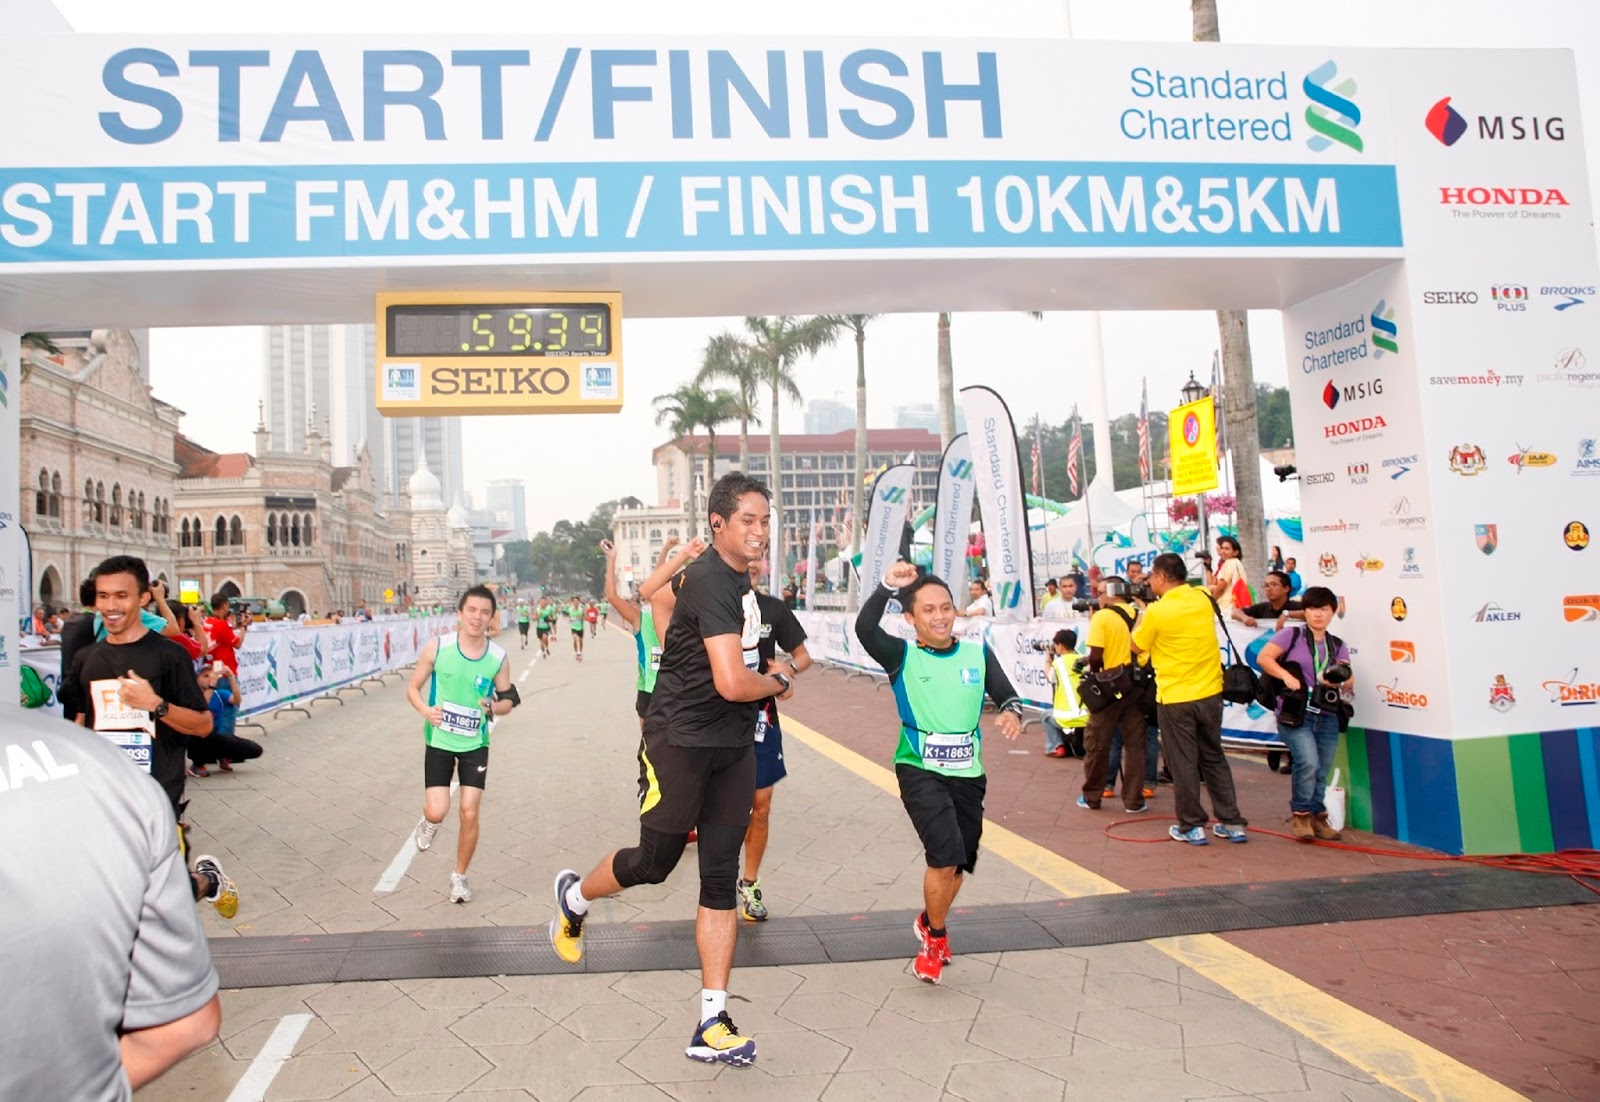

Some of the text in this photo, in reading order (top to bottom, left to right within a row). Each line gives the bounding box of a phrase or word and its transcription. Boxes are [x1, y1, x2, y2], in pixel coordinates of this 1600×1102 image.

[98, 47, 1003, 145] START/FINISH
[1131, 67, 1287, 101] Standard
[1120, 108, 1291, 142] Chartered
[1477, 115, 1566, 141] MSIG
[1438, 187, 1571, 206] HONDA
[0, 180, 267, 248] START
[295, 175, 599, 242] FM&HM
[680, 173, 930, 238] FINISH
[956, 174, 1341, 234] 10KM&5KM
[1452, 209, 1562, 220] The Power of Dreams
[1423, 291, 1479, 304] SEIKO
[1539, 286, 1596, 295] BROOKS
[1497, 302, 1527, 312] PLUS
[1304, 313, 1366, 350] Standard
[1302, 338, 1368, 374] Chartered
[431, 367, 570, 395] SEIKO
[1343, 378, 1384, 402] MSIG
[1324, 415, 1388, 439] HONDA
[1382, 454, 1418, 468] BROOKS
[1306, 472, 1336, 486] SEIKO
[983, 416, 1018, 576] Standard Chartered
[944, 483, 961, 546] Chartered
[874, 506, 892, 557] Chartered
[1485, 612, 1521, 622] AKLEH
